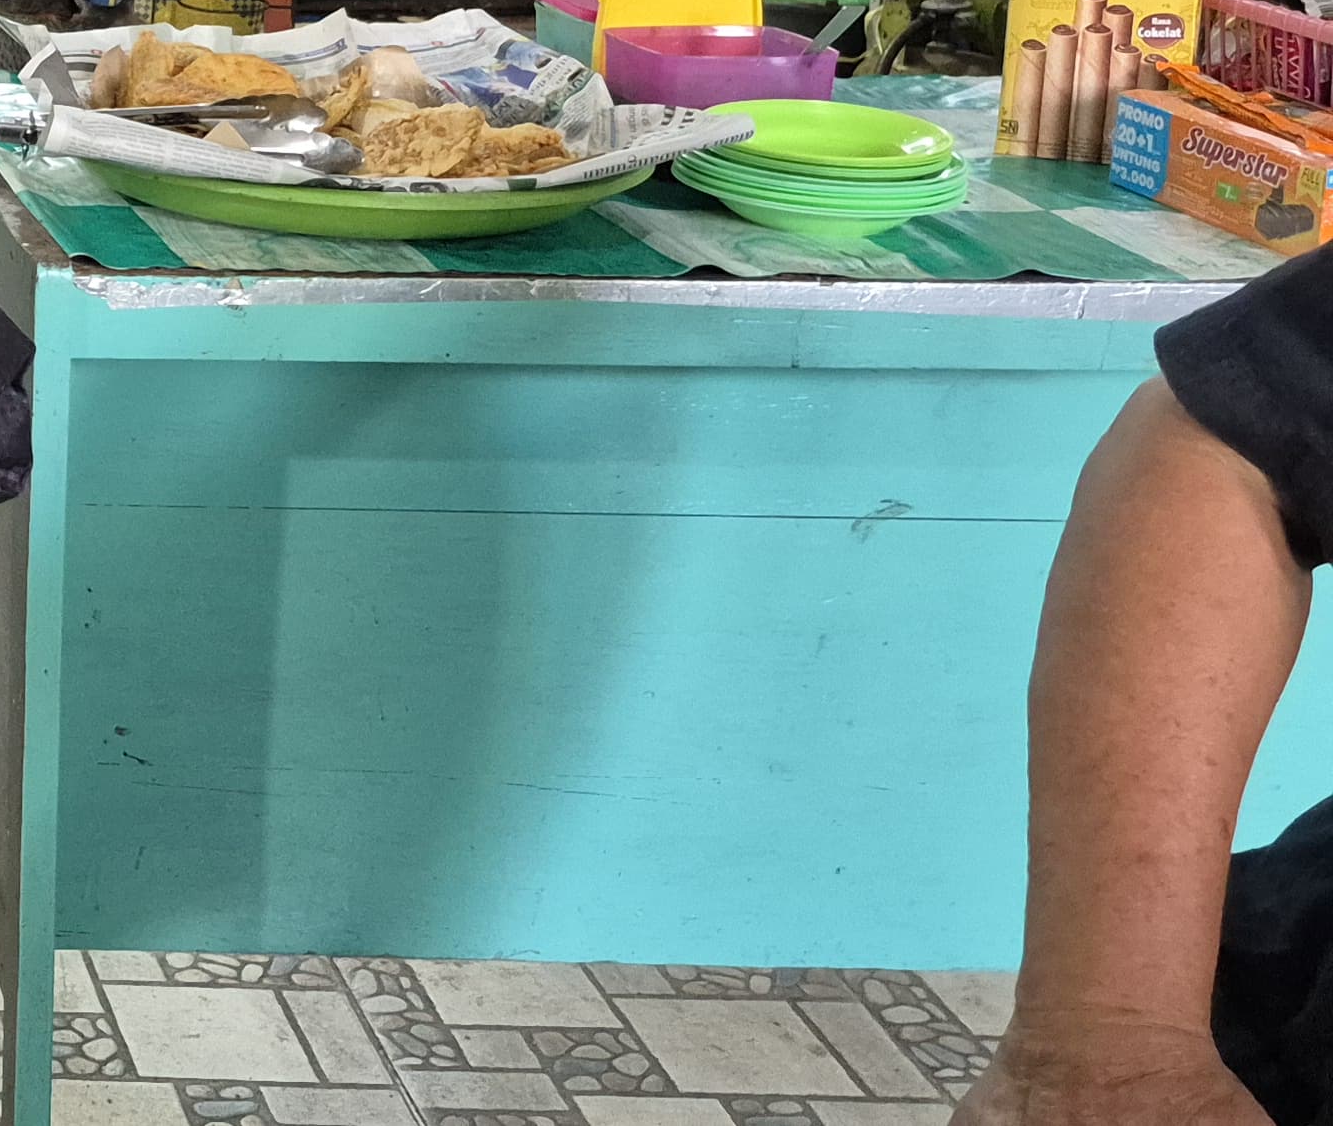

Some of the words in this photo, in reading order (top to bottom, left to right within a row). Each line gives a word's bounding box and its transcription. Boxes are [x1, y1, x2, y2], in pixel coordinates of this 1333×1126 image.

[1137, 27, 1182, 39] Cokelat
[1118, 101, 1165, 131] PROMO
[1117, 123, 1155, 153] 20+1
[1114, 145, 1161, 173] UNTUNG
[1182, 126, 1288, 188] Superstar
[1301, 166, 1321, 186] FULL
